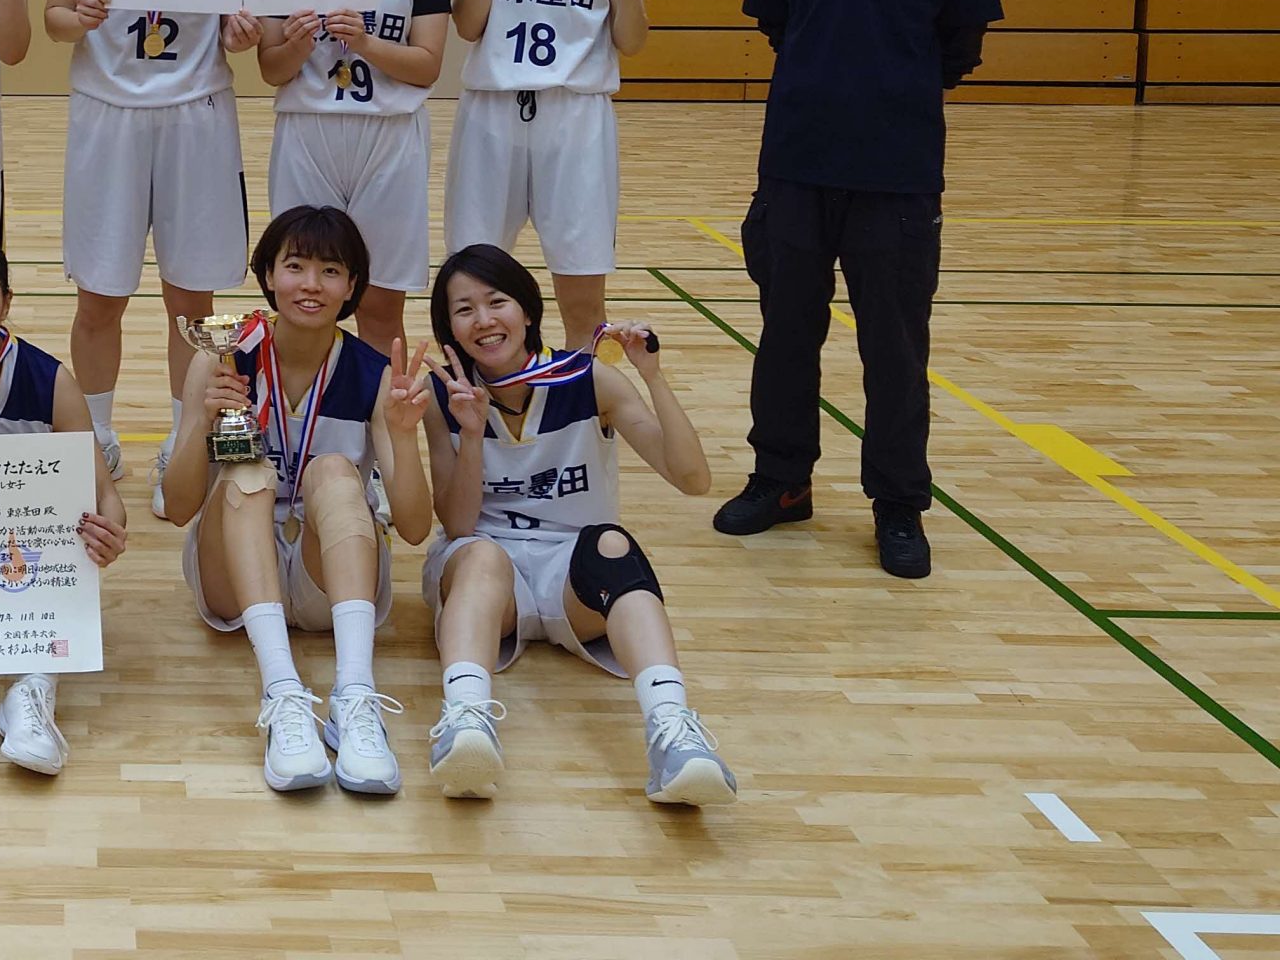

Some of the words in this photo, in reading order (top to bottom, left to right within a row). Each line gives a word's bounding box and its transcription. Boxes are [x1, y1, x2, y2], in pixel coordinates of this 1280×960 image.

[127, 16, 179, 61] 12
[505, 21, 557, 67] 18
[328, 59, 374, 102] 19
